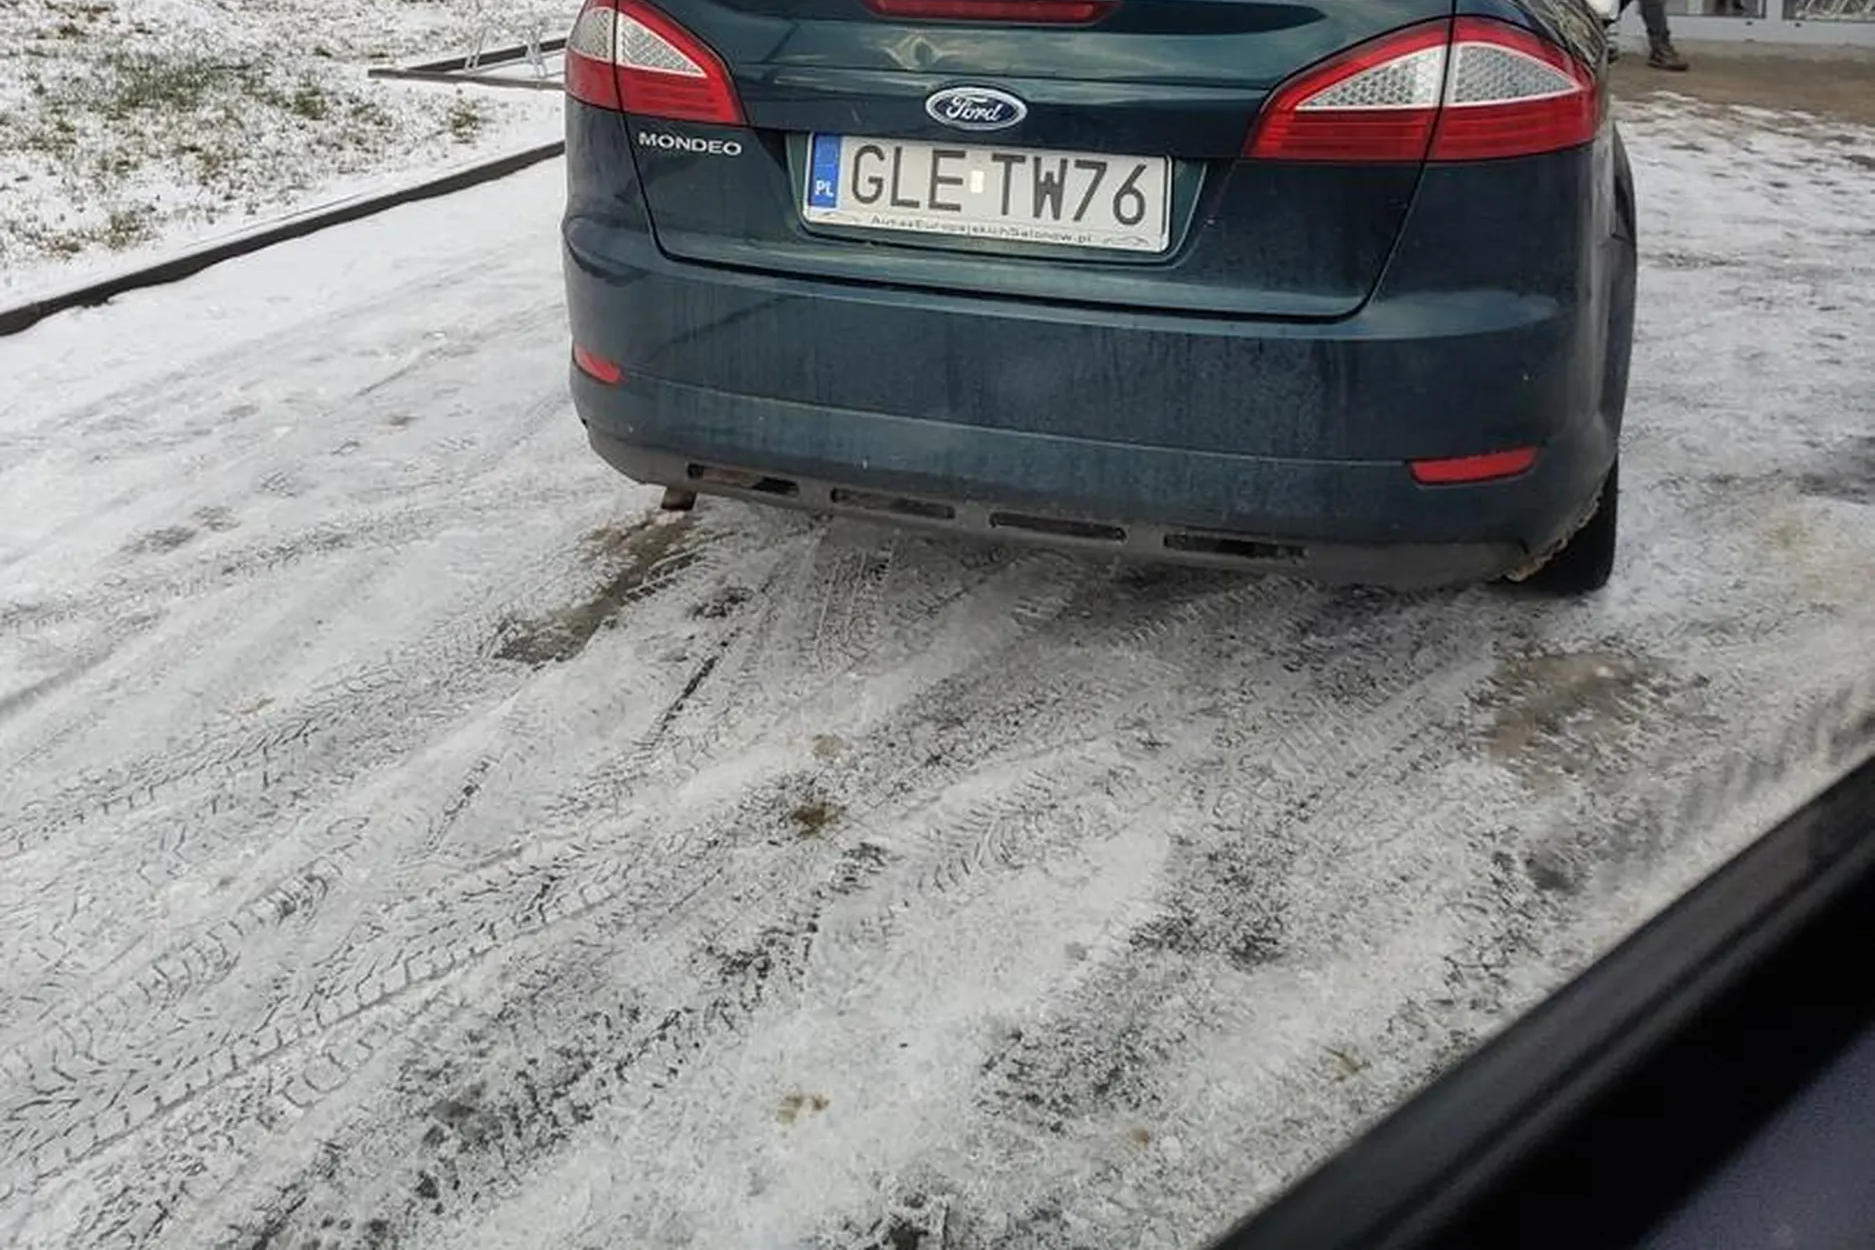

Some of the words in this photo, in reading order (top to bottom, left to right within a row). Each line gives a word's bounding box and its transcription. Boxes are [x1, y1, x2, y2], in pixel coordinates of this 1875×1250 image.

[946, 95, 1003, 121] Ford
[638, 132, 742, 156] MONDEO
[815, 179, 835, 197] PL
[851, 144, 966, 212] GLE
[991, 152, 1147, 226] TW76
